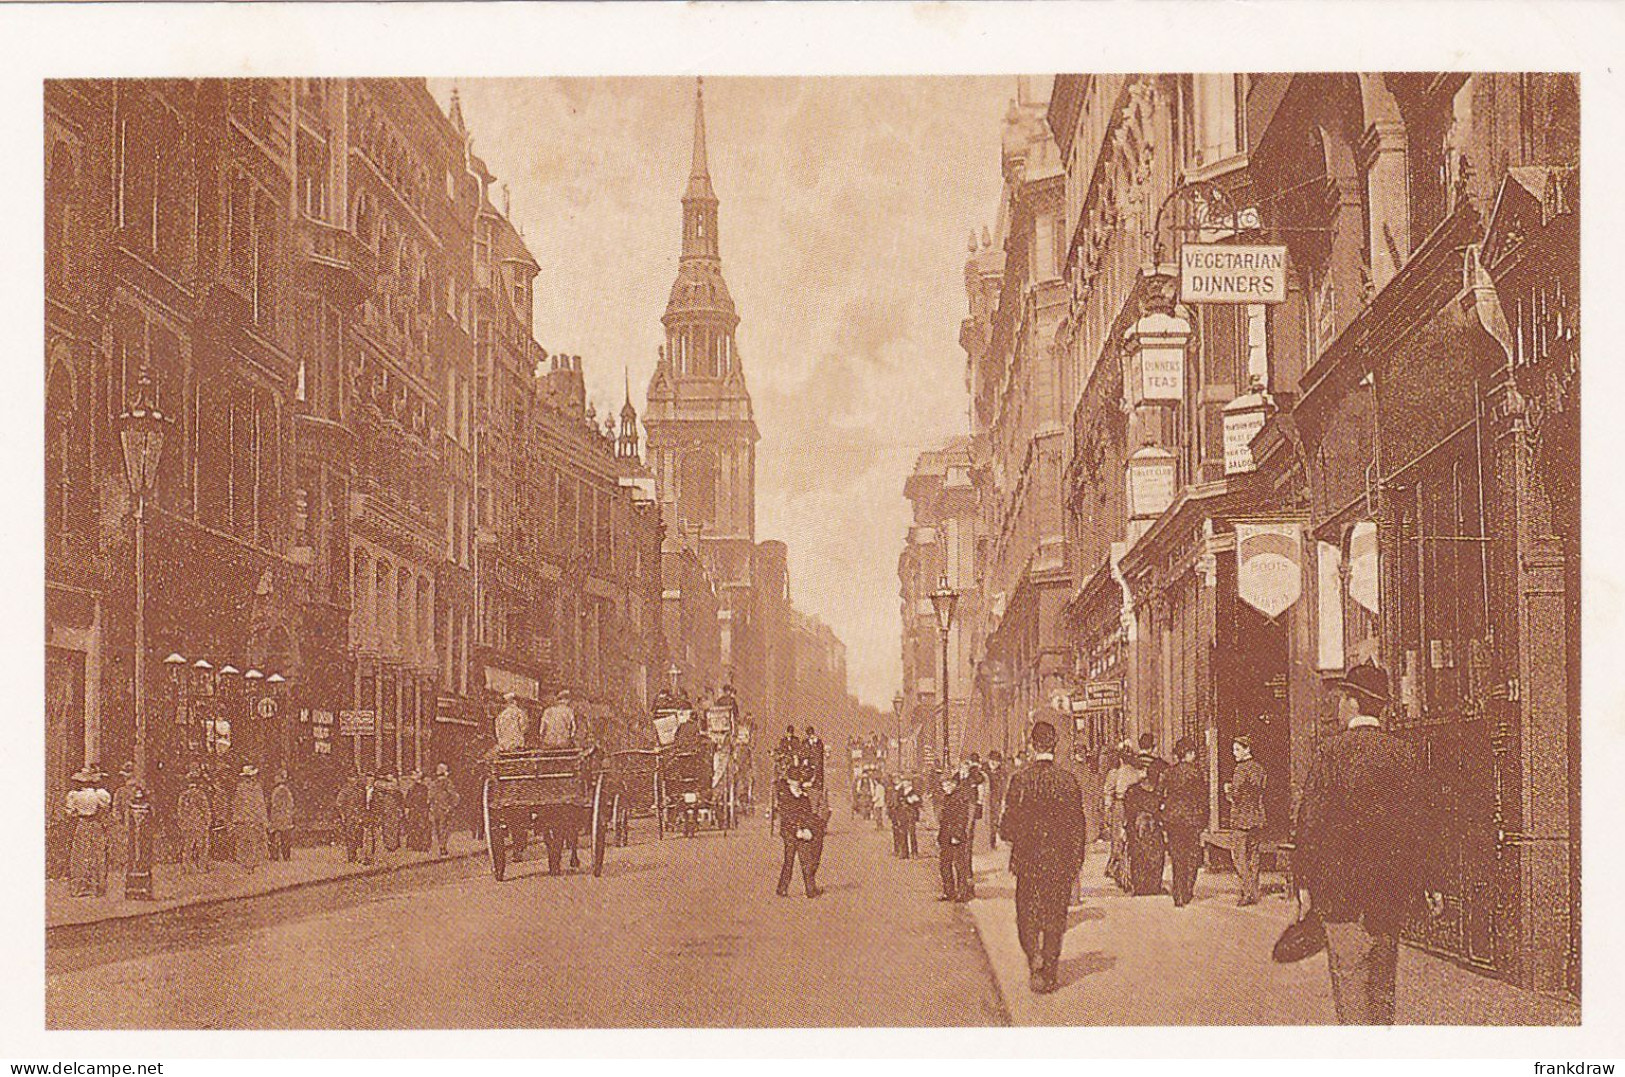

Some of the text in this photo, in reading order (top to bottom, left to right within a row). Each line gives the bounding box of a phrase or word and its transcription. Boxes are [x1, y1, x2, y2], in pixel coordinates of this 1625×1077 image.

[1185, 252, 1281, 271] VEGETARIAN
[1192, 276, 1274, 296] DINNERS
[1145, 360, 1180, 371] DINNERS
[1148, 376, 1178, 388] TEAS
